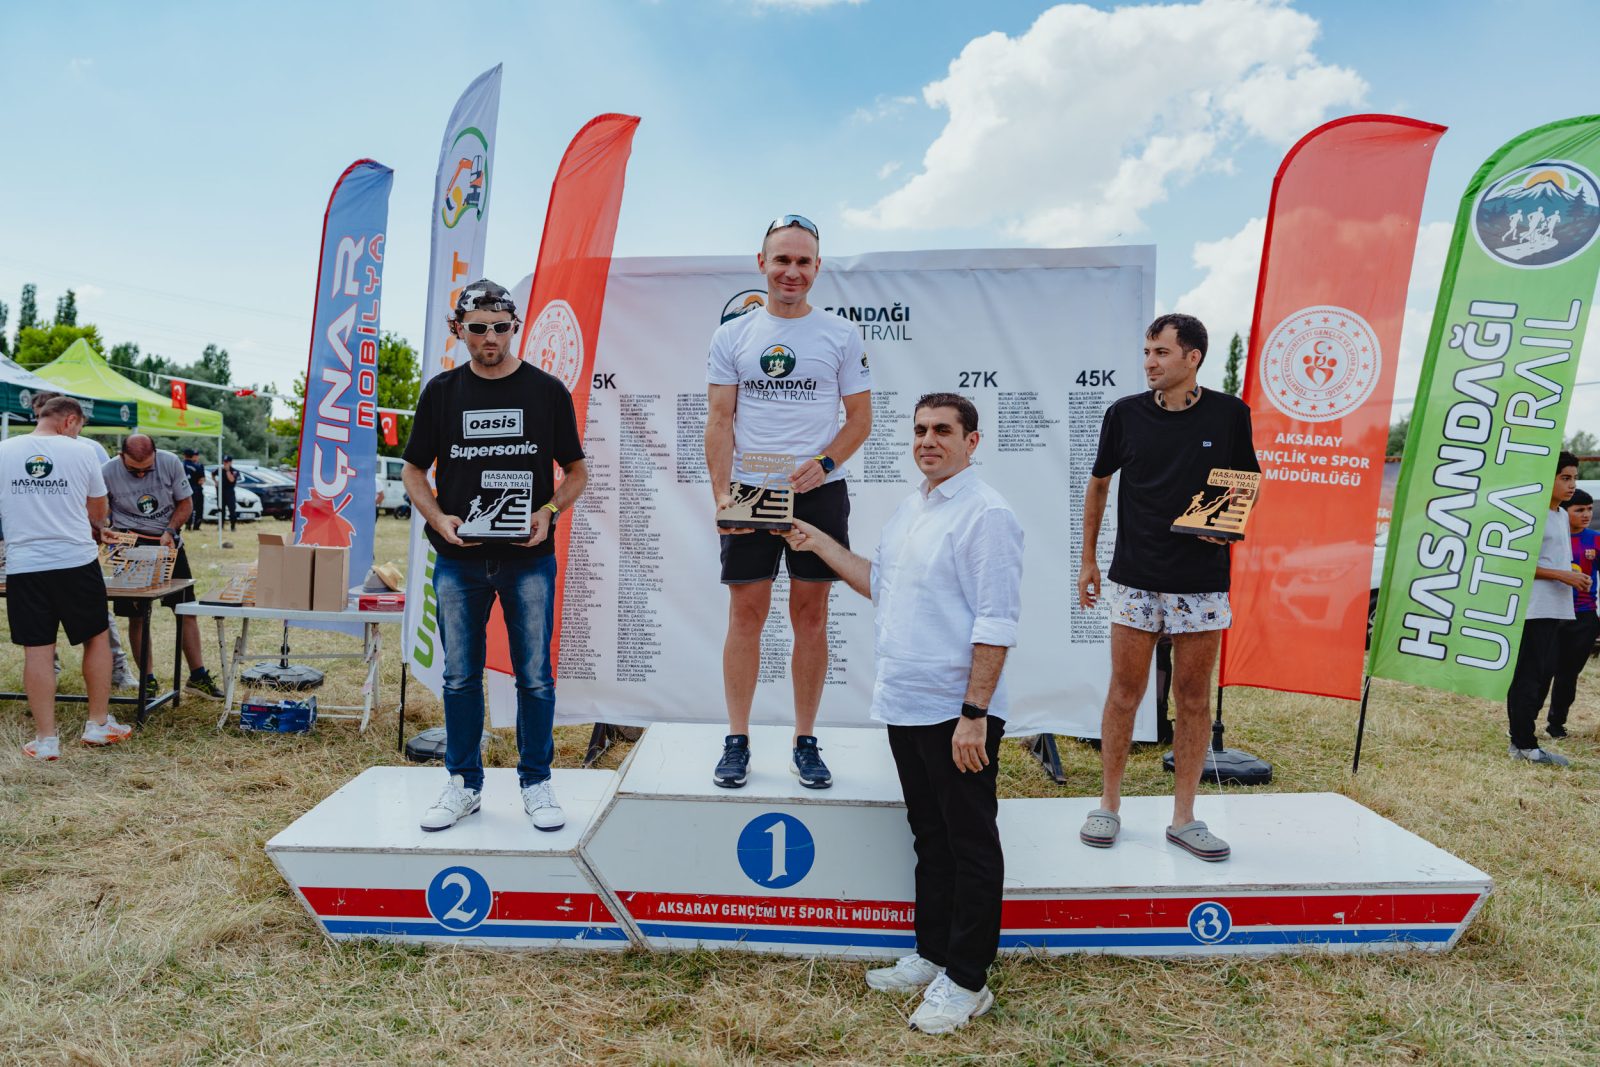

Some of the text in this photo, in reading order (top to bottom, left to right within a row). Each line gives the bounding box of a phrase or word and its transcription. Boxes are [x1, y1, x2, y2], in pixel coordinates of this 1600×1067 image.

[859, 324, 913, 341] TRAIL
[312, 236, 366, 498] ÇINAR
[743, 378, 817, 390] HASANDAĞI
[958, 371, 998, 388] 27K
[1075, 369, 1116, 387] 45K
[784, 390, 817, 400] TRAIL
[469, 415, 517, 430] oasis
[1275, 432, 1343, 448] AKSARAY
[450, 441, 538, 460] Supersonic
[1255, 450, 1371, 469] ENÇLİK ve SPOR
[11, 478, 68, 488] HASANDAĞI
[484, 472, 532, 480] HASANDAĞI
[1210, 479, 1234, 487] ULTRA
[1265, 468, 1362, 487] MÜDÜRLÜĞÜ
[1398, 300, 1518, 661] HASANDAĞI
[1455, 299, 1583, 671] ULTRA TRAIL
[43, 487, 68, 495] TRAIL
[763, 819, 789, 882] 1
[442, 872, 478, 921] 2
[657, 901, 719, 916] AKSARAY
[780, 905, 797, 918] VE
[798, 905, 834, 920] SPOR
[851, 906, 915, 922] MÜDÜRLÜ
[1195, 906, 1223, 939] 3
